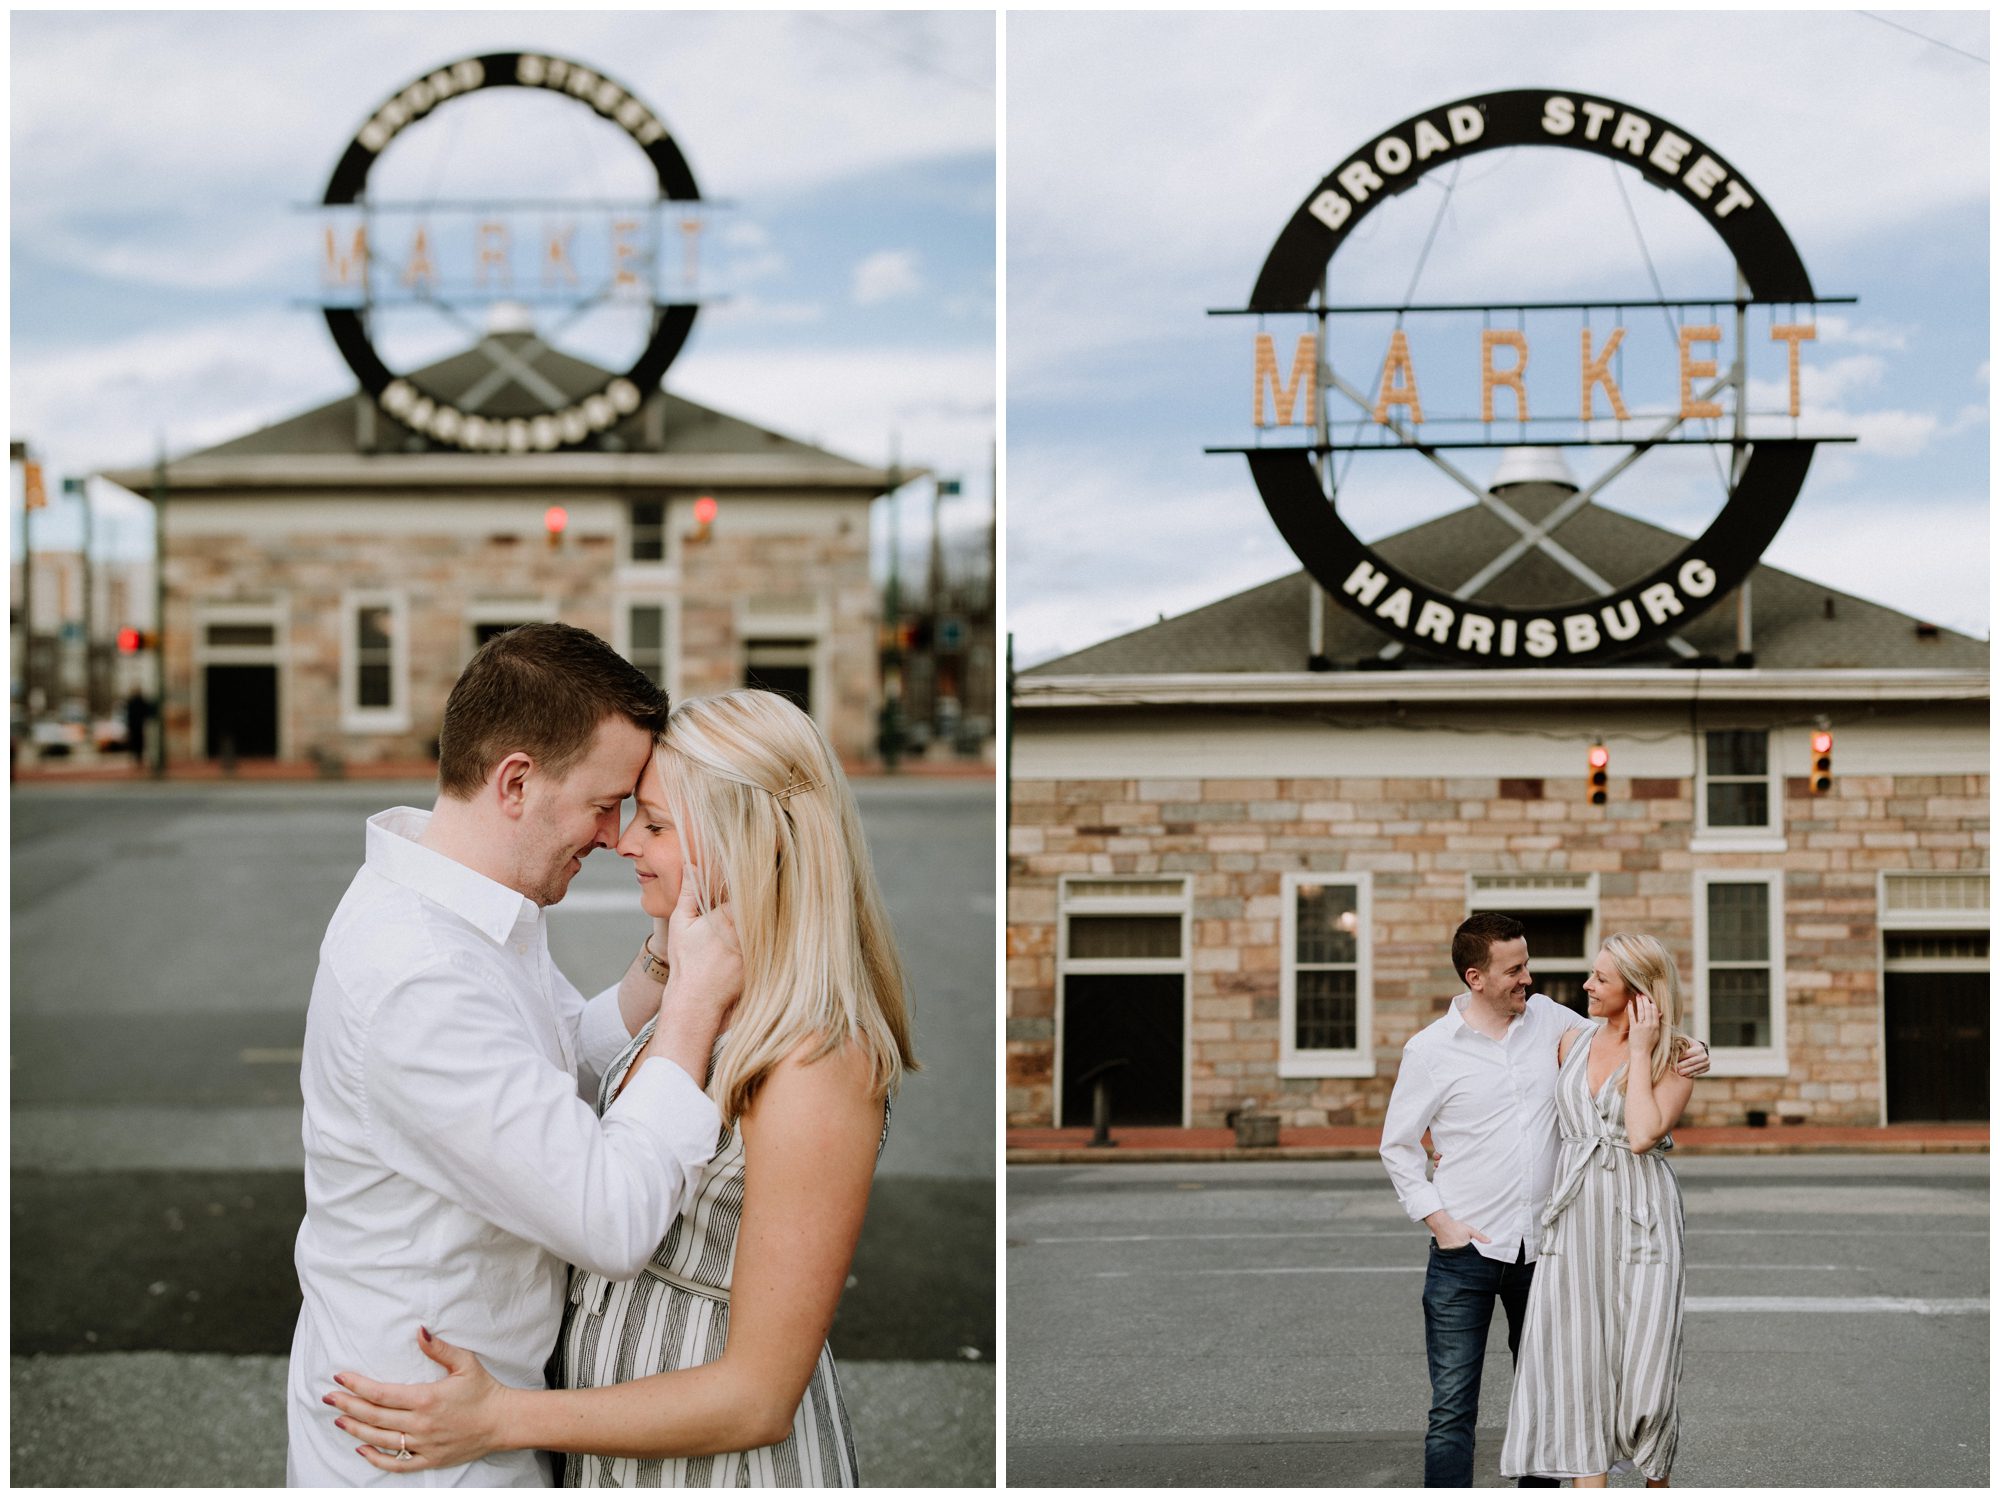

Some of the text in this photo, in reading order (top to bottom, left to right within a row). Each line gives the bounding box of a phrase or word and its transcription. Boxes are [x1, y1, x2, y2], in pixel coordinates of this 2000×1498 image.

[1310, 97, 1753, 230] BROAD STREET
[322, 222, 704, 288] MARKET
[1254, 326, 1816, 426] MARKET
[1343, 560, 1717, 656] HARRISBURG
